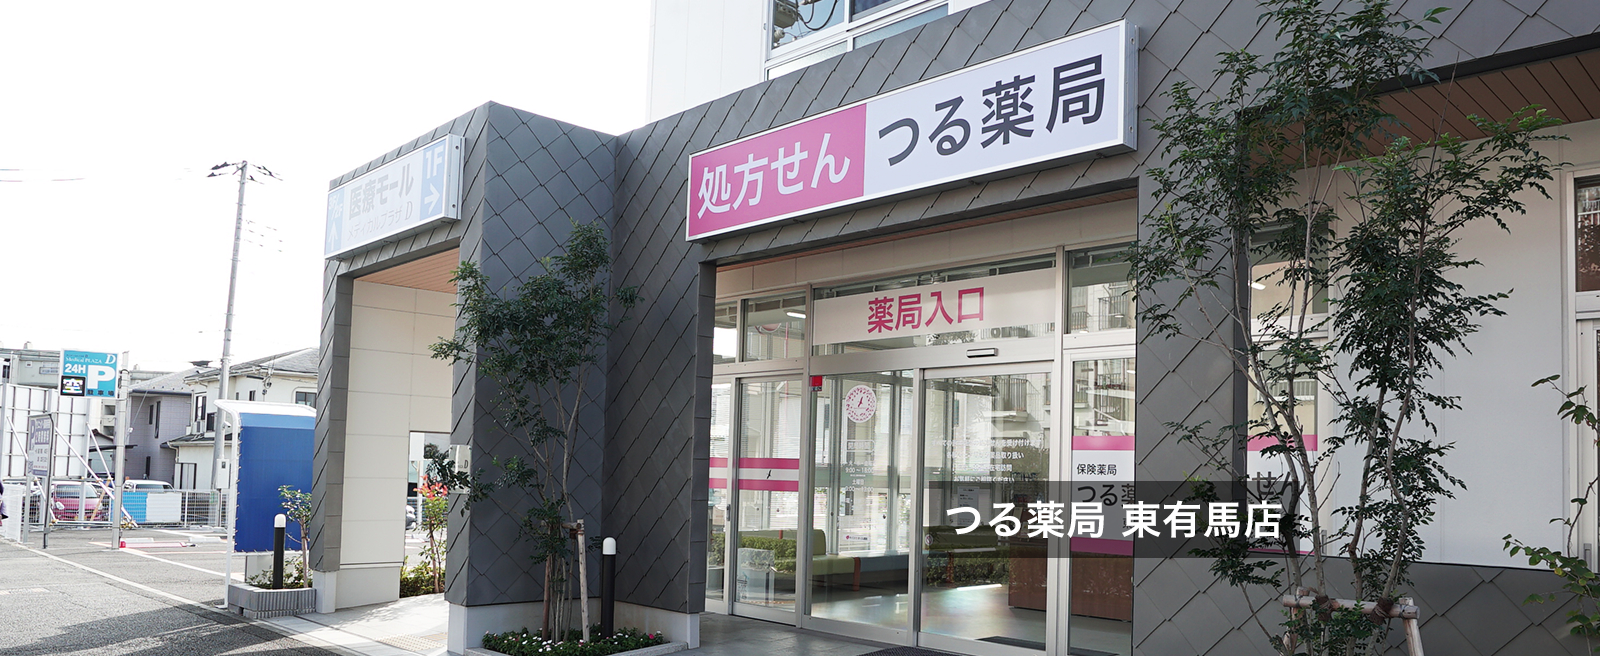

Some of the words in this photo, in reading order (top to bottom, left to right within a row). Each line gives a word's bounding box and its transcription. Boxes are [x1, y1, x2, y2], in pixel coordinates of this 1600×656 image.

[878, 53, 1106, 167] つる薬局
[425, 144, 444, 180] 1F
[697, 132, 851, 220] 処方せん
[348, 162, 414, 221] 医療モール
[347, 205, 402, 241] メディカルプラザ
[404, 200, 413, 221] D
[867, 287, 985, 334] 薬局入口
[64, 363, 86, 374] 24H
[87, 364, 116, 390] P
[105, 354, 116, 364] D
[1076, 463, 1117, 476] 保険薬局
